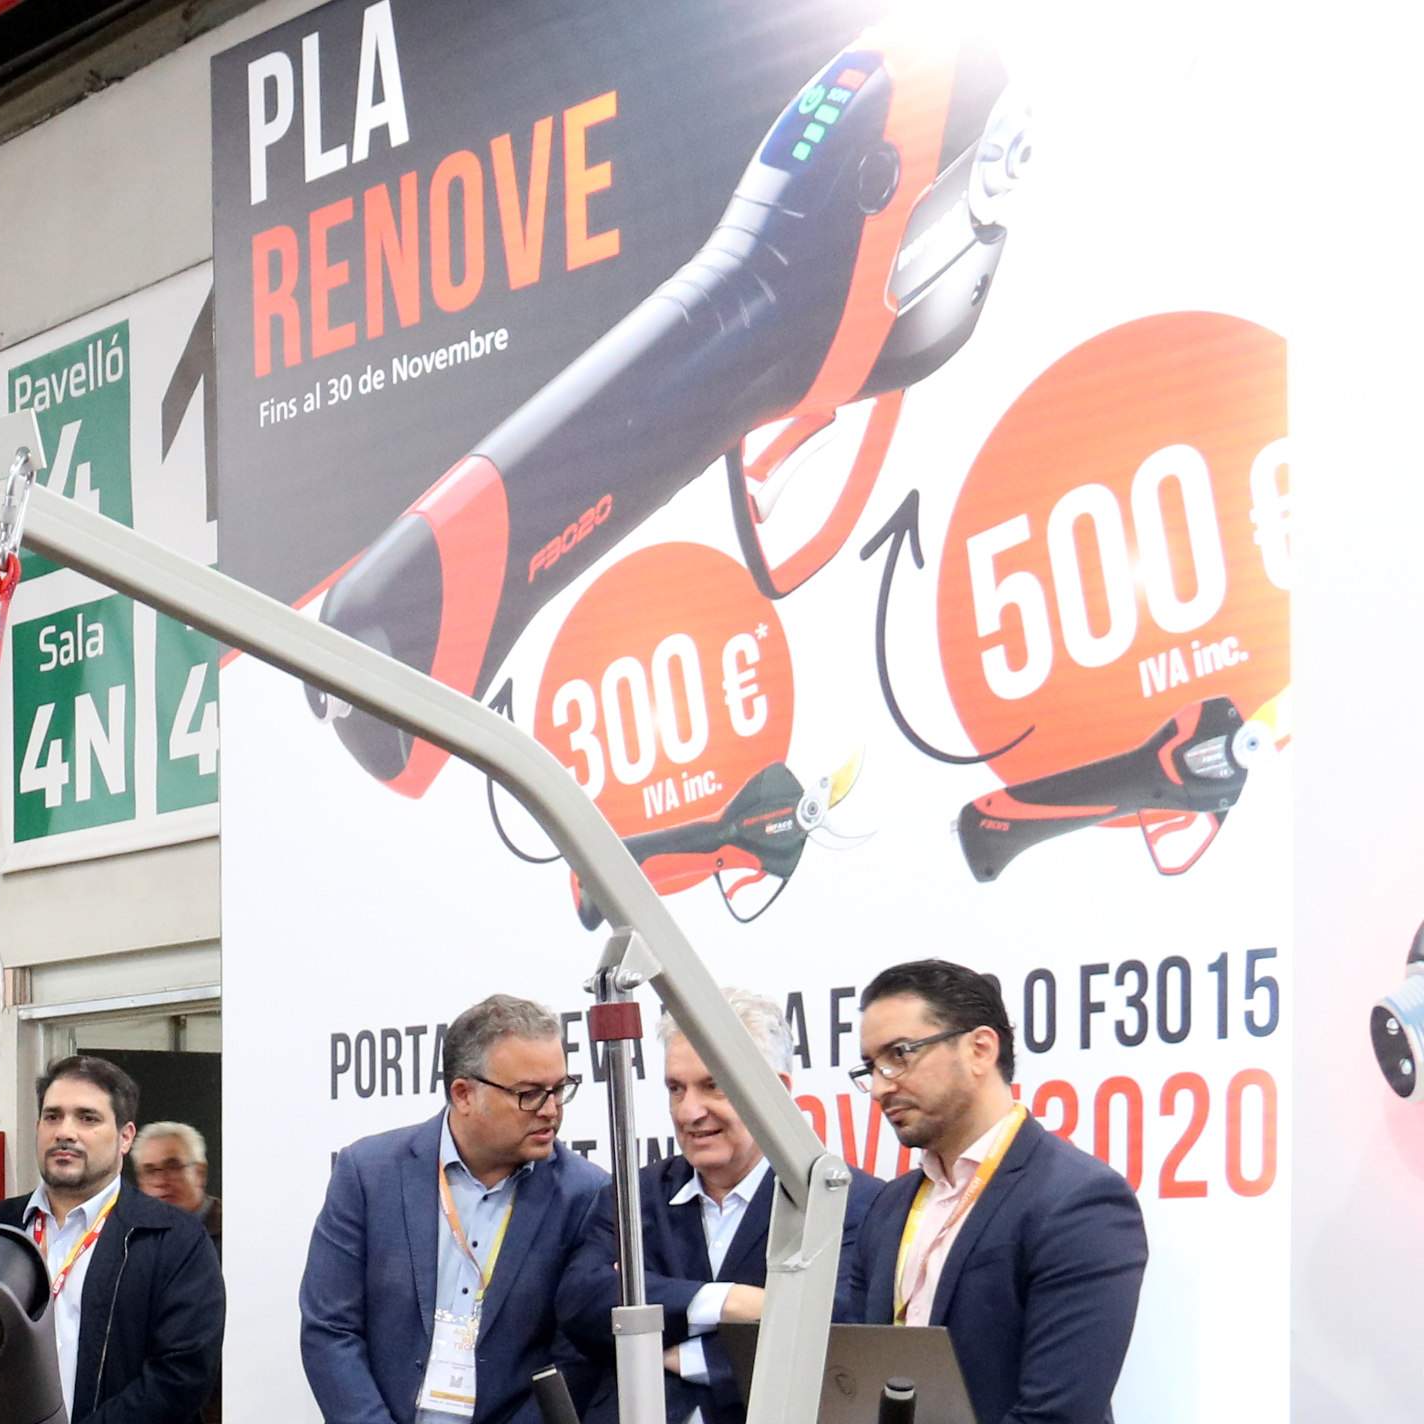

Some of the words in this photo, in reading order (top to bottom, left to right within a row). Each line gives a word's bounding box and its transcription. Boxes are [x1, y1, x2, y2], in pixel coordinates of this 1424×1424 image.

[248, 0, 410, 205] PLA
[252, 90, 620, 378] RENOVE
[15, 333, 124, 413] Pavelló
[259, 396, 297, 428] Fins
[303, 381, 321, 414] al
[327, 374, 353, 406] 30
[358, 364, 385, 396] de
[391, 326, 510, 385] Novembre
[966, 443, 1228, 700] 500
[38, 612, 105, 673] Sala
[1138, 646, 1189, 698] IVA
[1191, 635, 1250, 679] inc.
[19, 684, 127, 809] 4N
[552, 633, 710, 801] 300
[642, 776, 679, 819] IVA
[682, 770, 724, 803] inc.
[1079, 947, 1280, 1051] F3015
